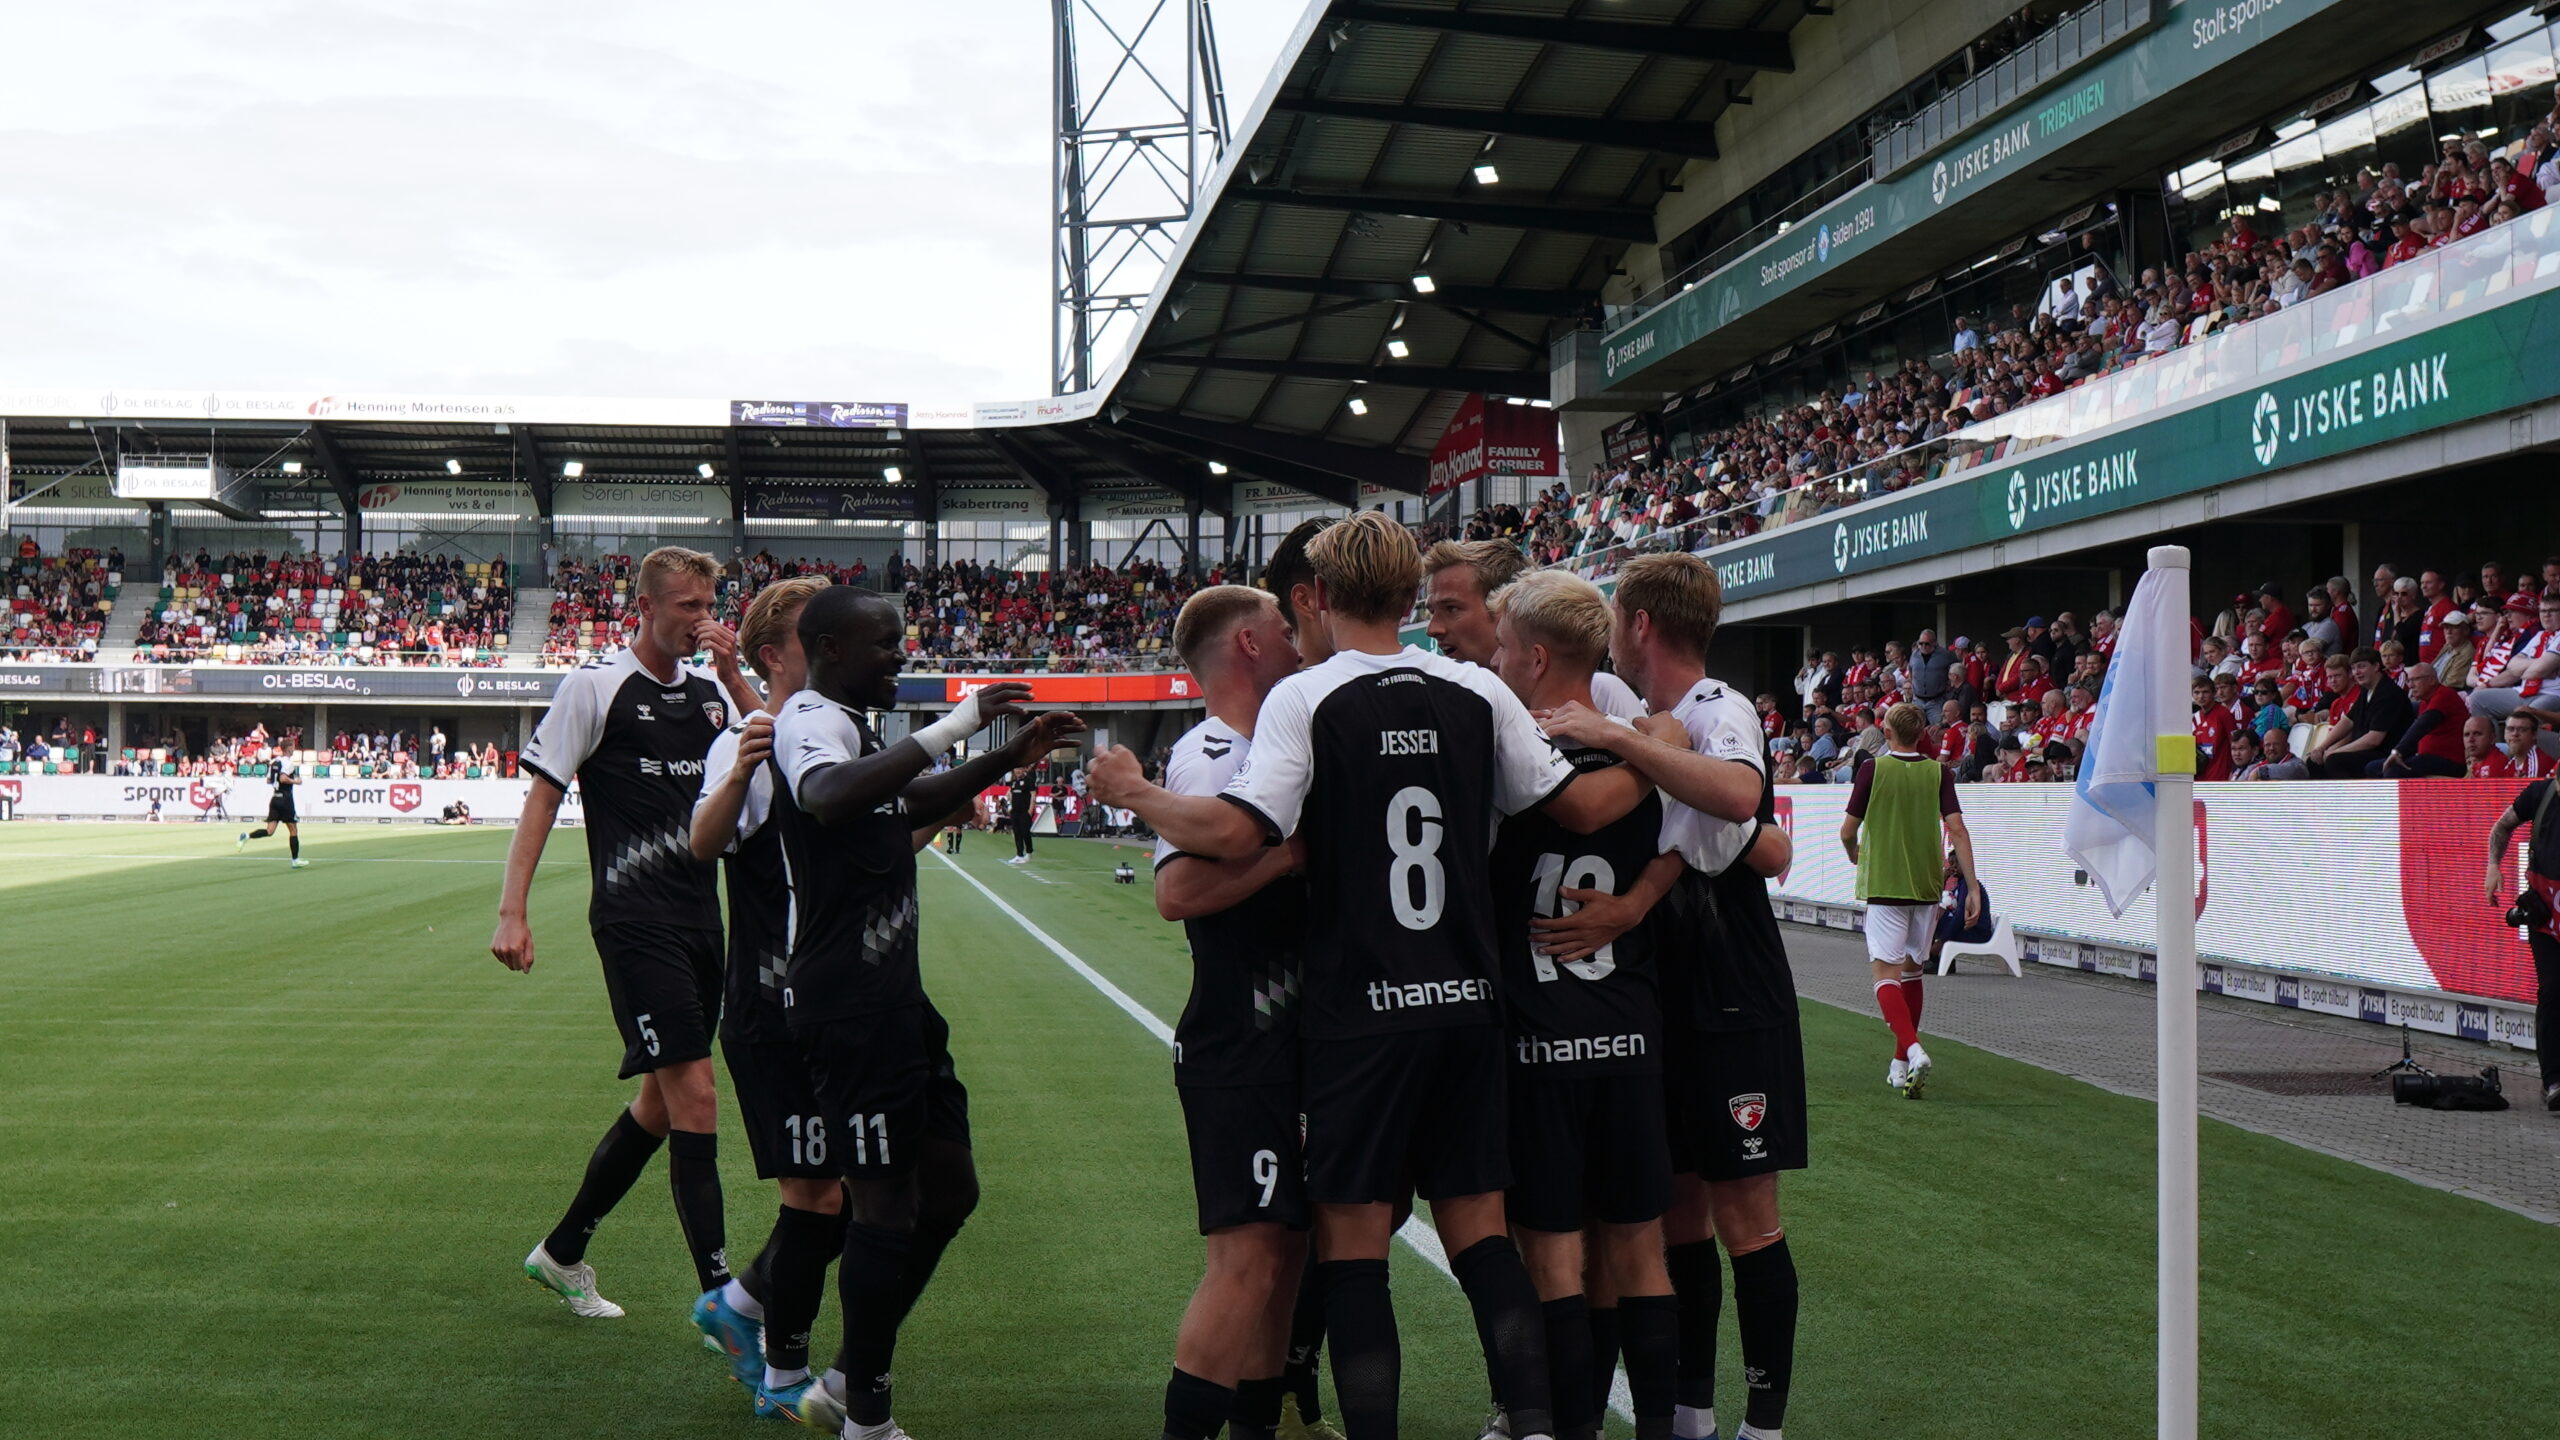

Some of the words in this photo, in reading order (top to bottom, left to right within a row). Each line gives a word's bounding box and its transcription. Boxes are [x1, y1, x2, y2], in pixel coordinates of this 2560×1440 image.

[2193, 7, 2227, 49] Stolt
[1951, 143, 1989, 188] JYSKE
[1993, 121, 2030, 164] BANK
[2038, 79, 2105, 139] TRIBUNEN
[1832, 220, 1854, 249] siden
[1854, 206, 1875, 232] 1991
[1760, 259, 1777, 287] Stolt
[1777, 244, 1808, 282] sponsor
[1808, 236, 1817, 261] af
[1615, 339, 1635, 368] JYSKE
[1636, 328, 1655, 357] BANK
[347, 402, 406, 415] Henning
[412, 402, 489, 415] Mortensen
[495, 403, 515, 415] a/s
[741, 402, 794, 421] Radisson
[2289, 379, 2363, 443] JYSKE
[2373, 353, 2449, 418] BANK
[832, 403, 884, 422] Radisson
[1487, 446, 1541, 458] FAMILY
[1487, 459, 1545, 471] CORNER
[404, 485, 451, 497] Henning
[456, 486, 518, 498] Mortensen
[582, 485, 633, 501] Søren
[641, 486, 703, 502] Jensen
[2032, 464, 2083, 513] JYSKE
[2088, 448, 2138, 497] BANK
[449, 501, 469, 510] vvs
[473, 501, 481, 510] &
[485, 501, 495, 510] el
[756, 491, 814, 512] Radisson
[841, 492, 899, 513] Radisson
[943, 498, 1029, 513] Skabertrang
[1852, 521, 1888, 558] JYSKE
[1892, 510, 1928, 550] BANK
[1747, 552, 1775, 585] BANK
[478, 681, 493, 690] OL
[496, 681, 540, 691] BESLAG
[1379, 729, 1439, 756] JESSEN
[124, 786, 187, 801] SPORT
[323, 788, 386, 804] SPORT
[392, 788, 421, 804] 24
[1368, 978, 1494, 1012] thansen
[2206, 969, 2223, 986] JYSK
[2227, 973, 2233, 987] Et
[2233, 974, 2247, 992] godt
[2248, 975, 2266, 993] tilbud
[2279, 980, 2298, 999] JYSK
[2303, 985, 2311, 1000] Et
[2311, 987, 2327, 1006] godt
[2328, 988, 2349, 1007] tilbud
[2364, 993, 2385, 1014] JYSK
[2391, 999, 2400, 1016] Et
[2400, 1001, 2419, 1021] godt
[2420, 1003, 2444, 1023] tilbud
[636, 1013, 660, 1057] 5
[2462, 1009, 2487, 1031] JYSK
[2495, 1015, 2504, 1034] Et
[2505, 1018, 2527, 1039] godt
[1517, 1033, 1646, 1064] thansen
[785, 1114, 827, 1166] 18
[848, 1113, 890, 1165] 11
[1252, 1149, 1278, 1208] 9
